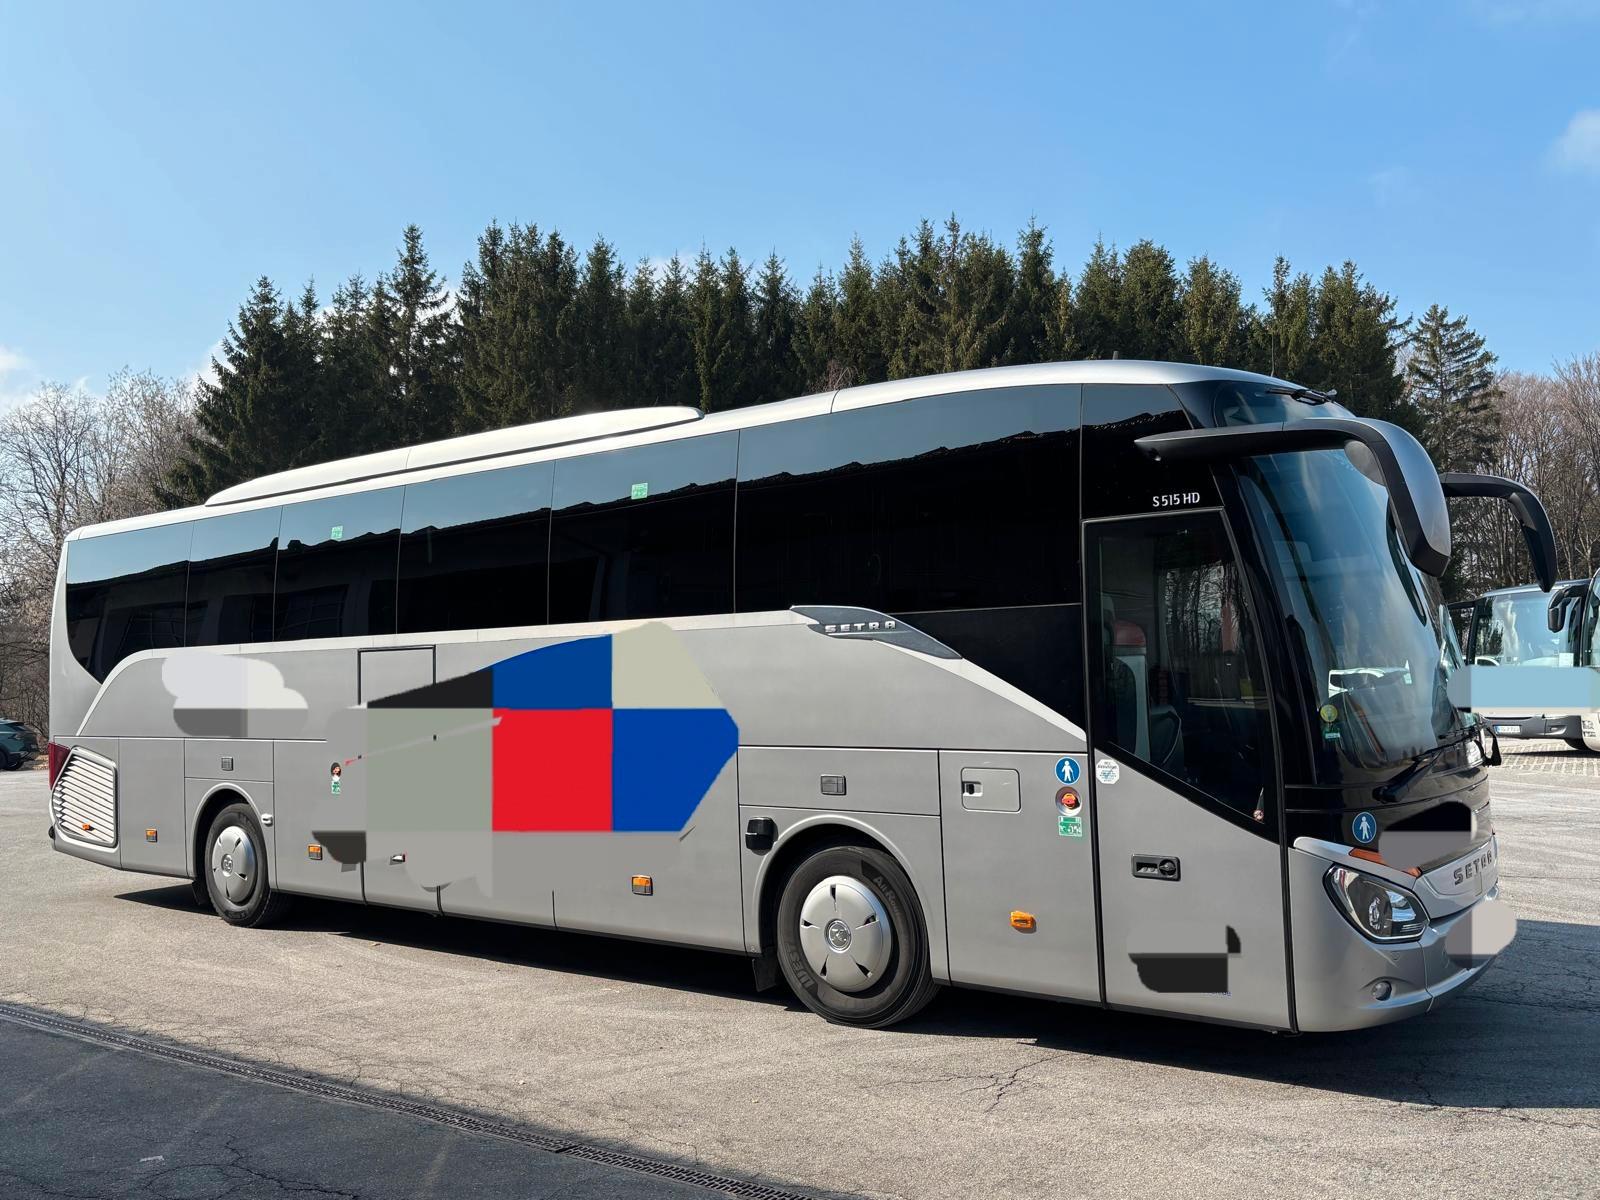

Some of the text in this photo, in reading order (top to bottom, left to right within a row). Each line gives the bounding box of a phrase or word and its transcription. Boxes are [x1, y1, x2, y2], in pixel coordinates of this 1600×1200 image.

[1152, 492, 1200, 507] S 515 HD
[824, 620, 896, 633] SETRA
